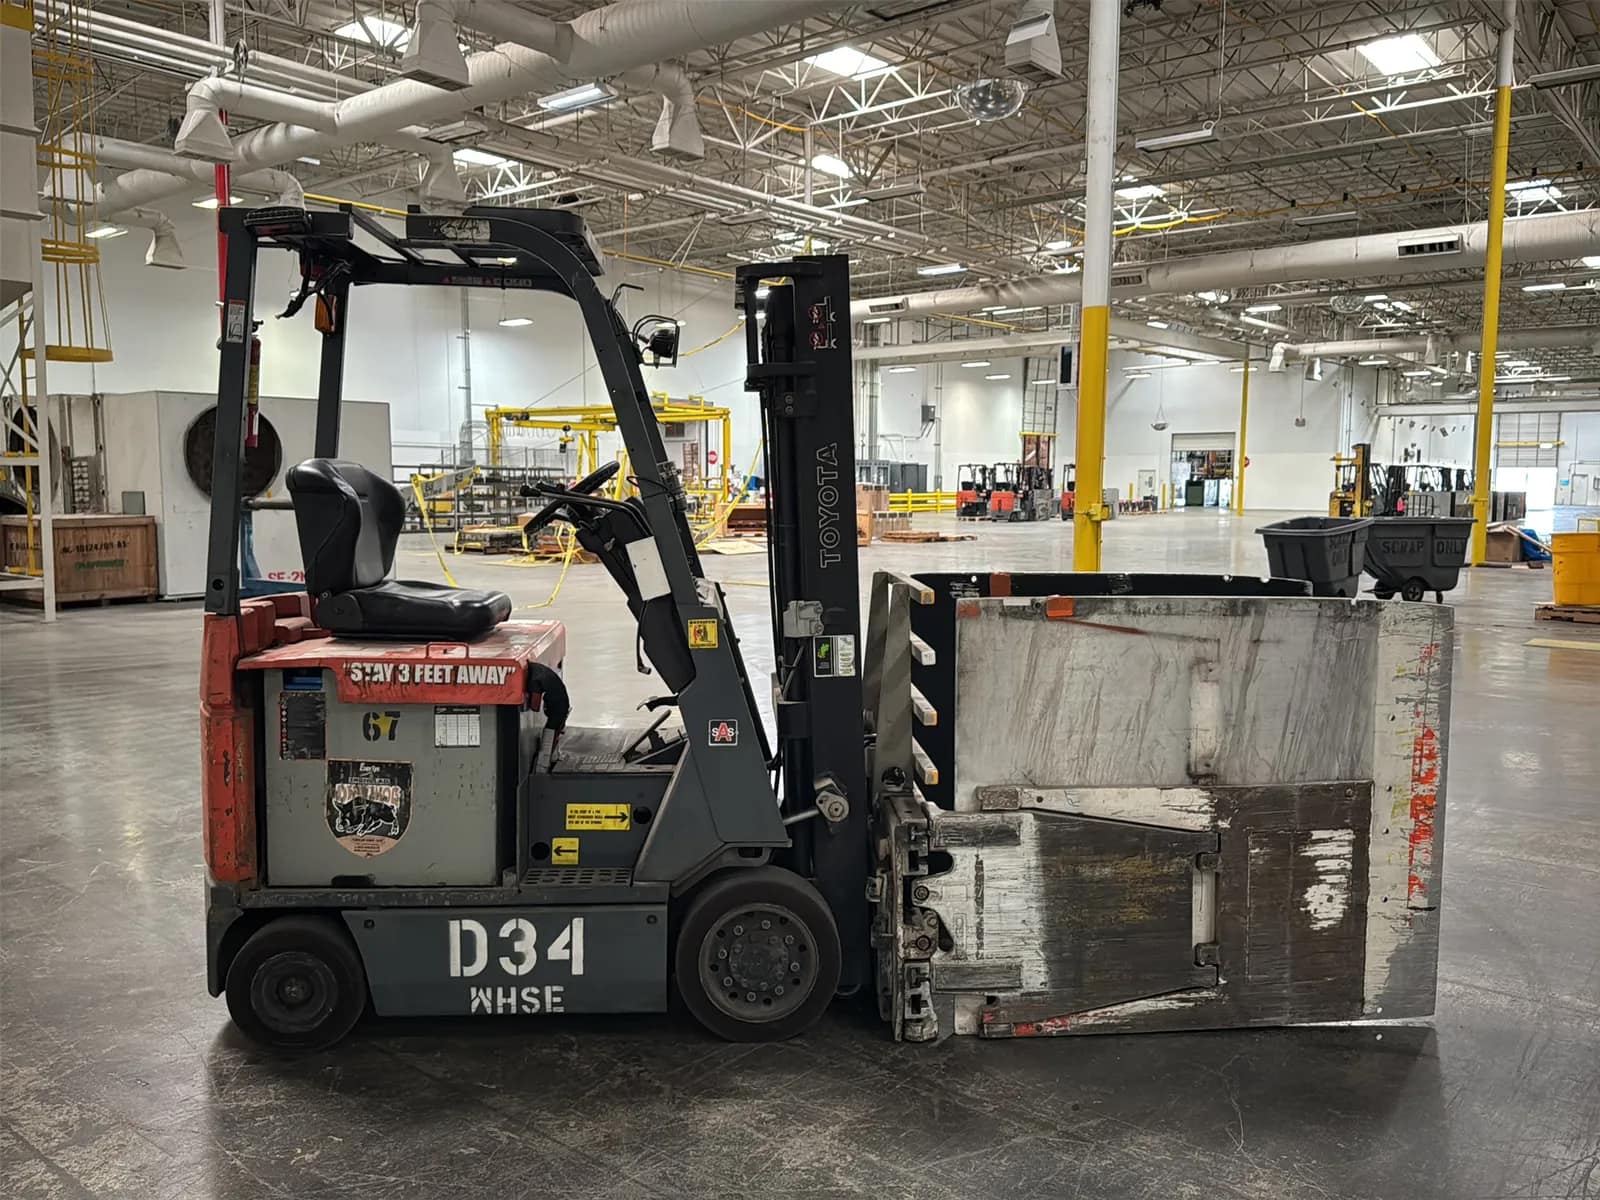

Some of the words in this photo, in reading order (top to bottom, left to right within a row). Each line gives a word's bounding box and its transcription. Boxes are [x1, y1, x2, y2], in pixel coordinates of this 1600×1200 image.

[816, 442, 841, 568] TOYOTA
[1382, 541, 1424, 554] SCRAP
[398, 664, 410, 683] 3
[414, 664, 455, 684] FEET
[456, 666, 515, 685] AWAY"
[362, 711, 400, 742] 67
[711, 722, 735, 742] SAS
[448, 917, 584, 977] D34
[470, 985, 565, 1014] WHSE
